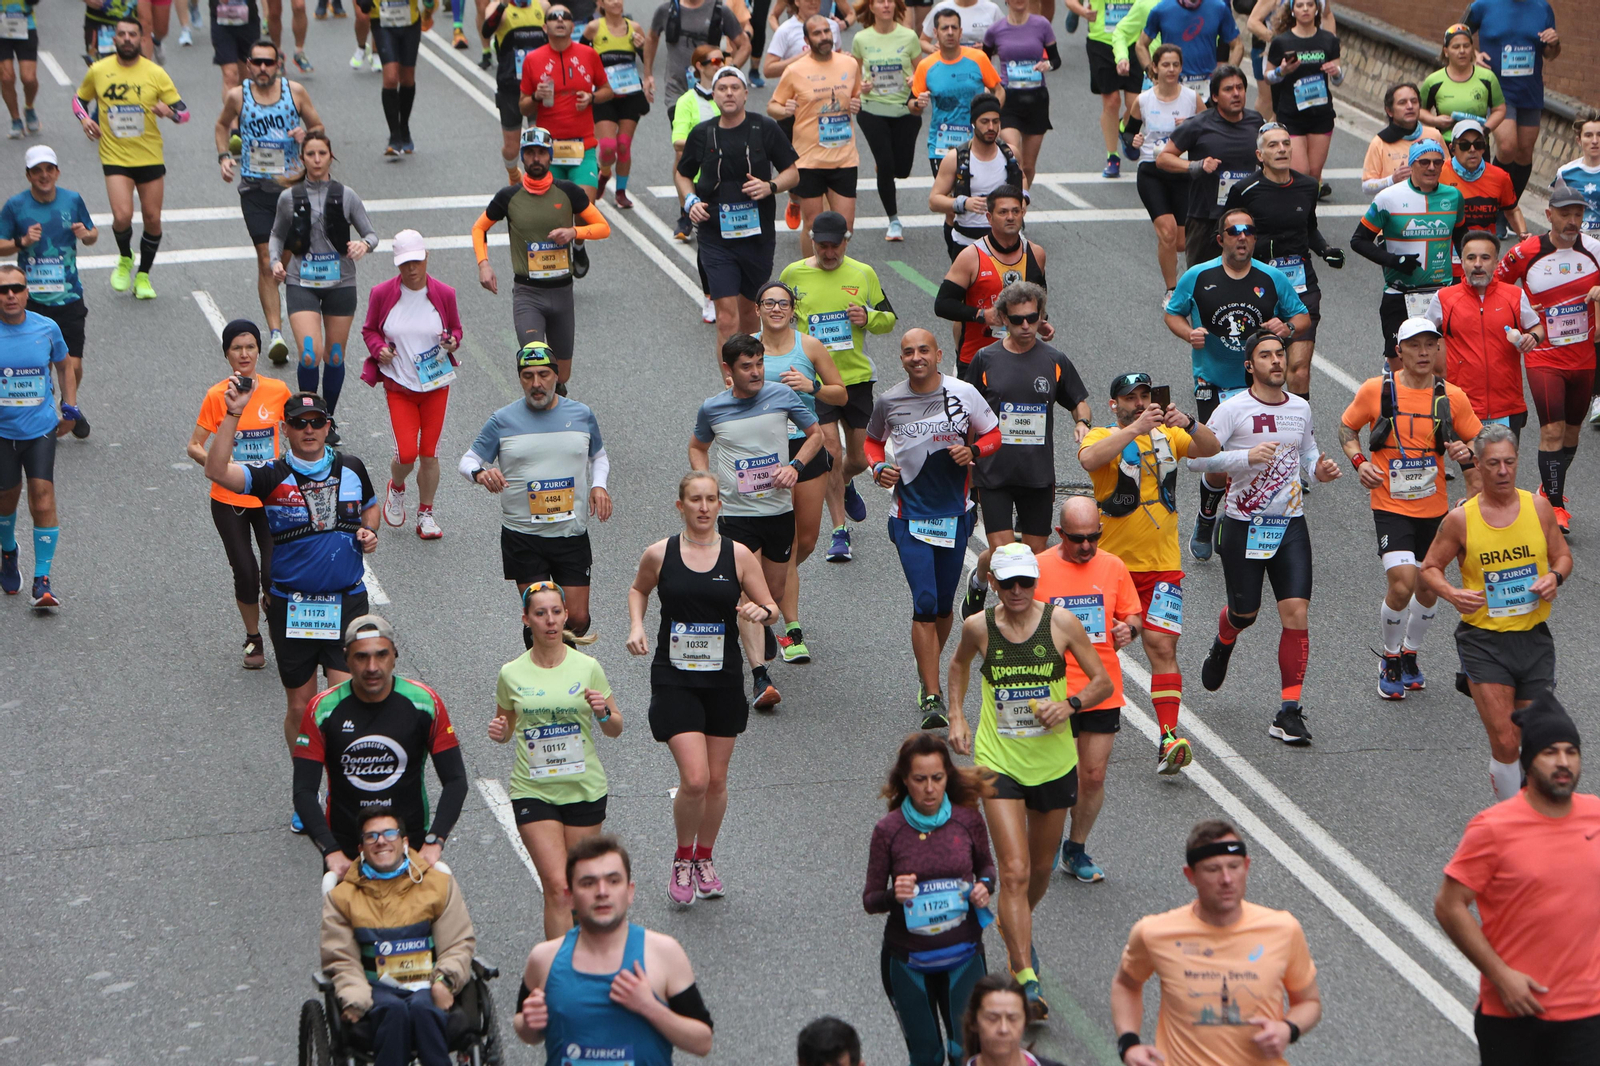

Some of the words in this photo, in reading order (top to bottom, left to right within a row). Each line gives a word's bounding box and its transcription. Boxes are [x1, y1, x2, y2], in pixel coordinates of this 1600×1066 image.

[249, 114, 285, 138] COMO
[731, 203, 754, 211] ZURICH
[37, 256, 62, 265] ZURICH
[314, 254, 335, 263] ZURICH
[1561, 305, 1584, 313] ZURICH
[822, 312, 845, 321] ZURICH
[821, 326, 839, 334] 10965
[15, 368, 40, 377] ZURICH
[13, 381, 32, 390] 10674
[246, 430, 271, 438] ZURICH
[933, 434, 958, 443] JEREZ
[751, 457, 776, 467] ZURICH
[753, 472, 769, 481] 7430
[545, 495, 561, 503] 4484
[917, 527, 948, 537] ALEJANDRO
[1480, 545, 1535, 566] BRASIL
[1502, 567, 1532, 580] ZURICH
[1502, 585, 1525, 596] 11066
[1068, 597, 1098, 607] ZURICH
[1505, 597, 1526, 606] PAULO
[303, 609, 326, 618] 11173
[690, 625, 720, 634] ZURICH
[686, 640, 709, 649] 10332
[683, 652, 711, 660] Samantha
[991, 663, 1054, 681] DEPORTEMANIA
[1012, 689, 1045, 699] ZURICH
[543, 725, 573, 737] ZURICH
[542, 743, 567, 753] 10112
[341, 752, 395, 764] Donando
[546, 757, 567, 765] Soraya
[343, 763, 395, 776] Vidas
[923, 880, 958, 892] ZURICH
[923, 901, 949, 912] 11725
[396, 942, 426, 952] ZURICH
[584, 1047, 626, 1060] ZURICH
